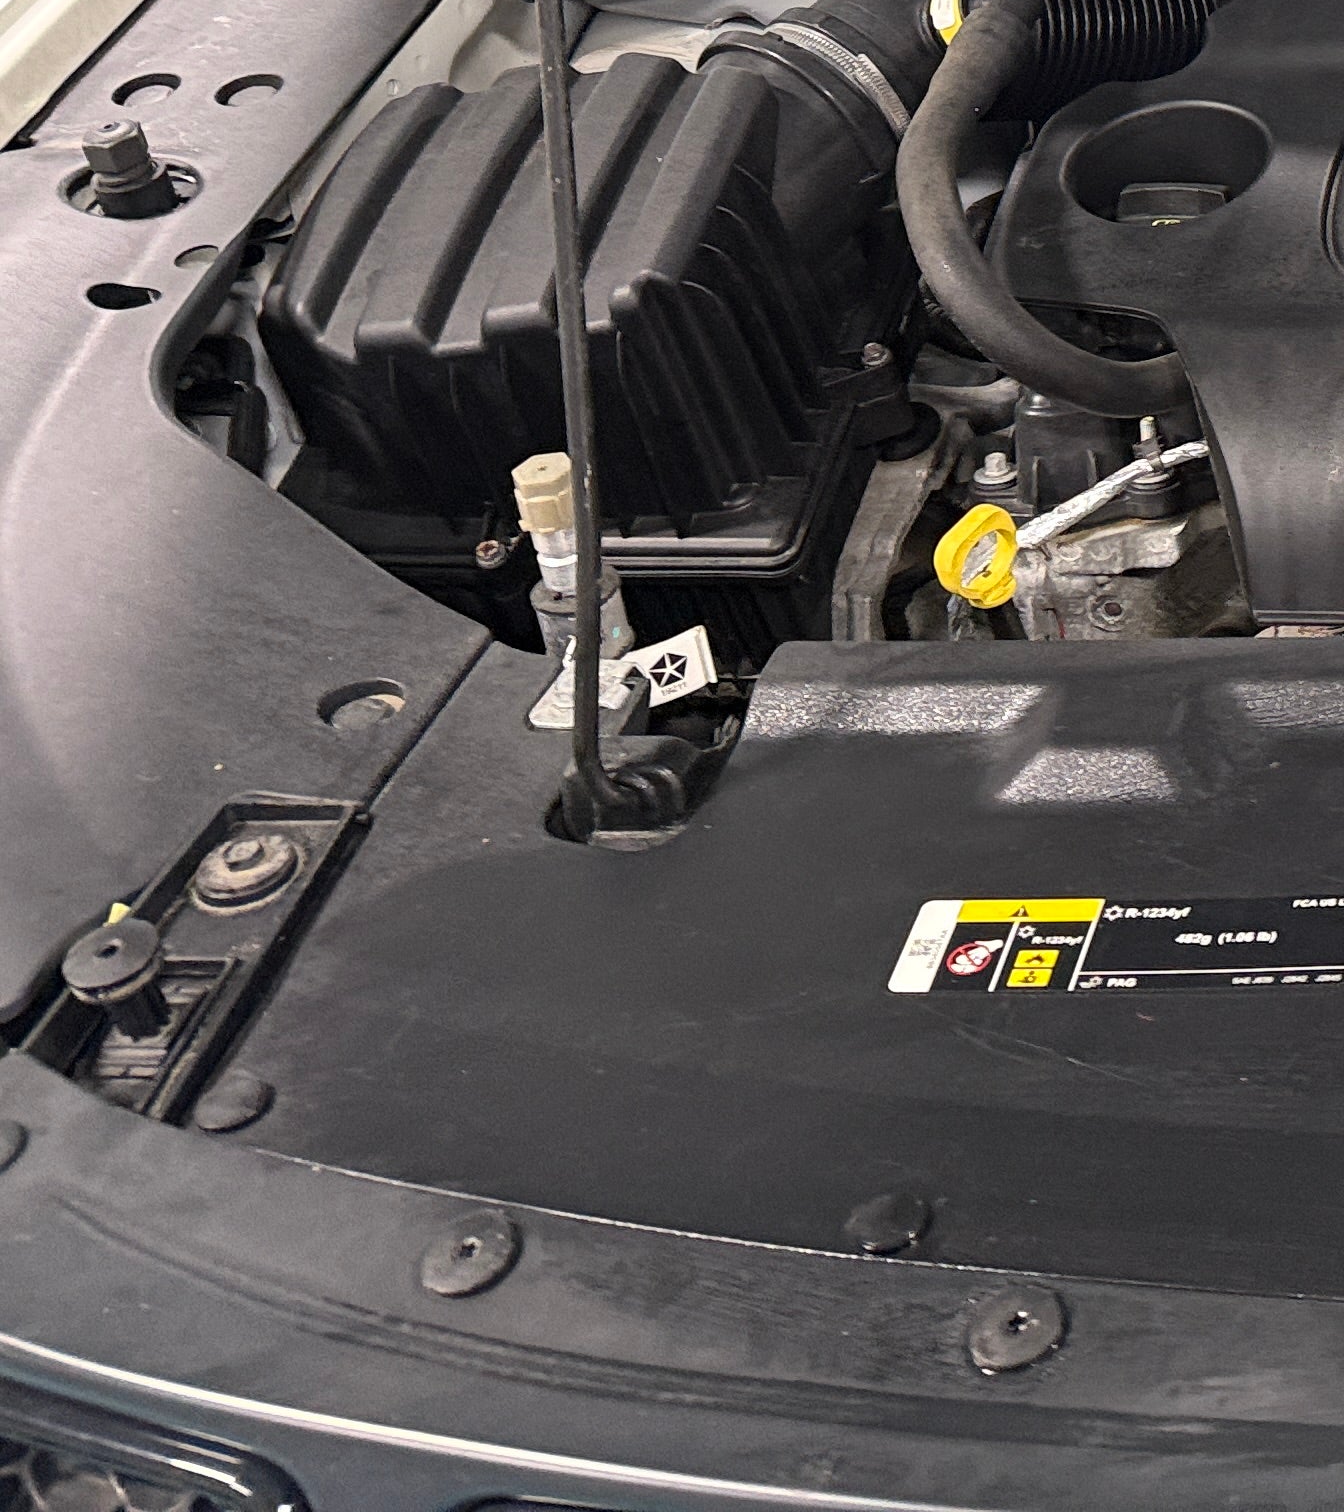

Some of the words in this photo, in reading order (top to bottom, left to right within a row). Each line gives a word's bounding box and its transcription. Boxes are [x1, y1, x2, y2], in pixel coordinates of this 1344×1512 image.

[1292, 898, 1319, 909] FCA
[1124, 906, 1193, 921] R-1234yf
[1106, 977, 1138, 988] PAG
